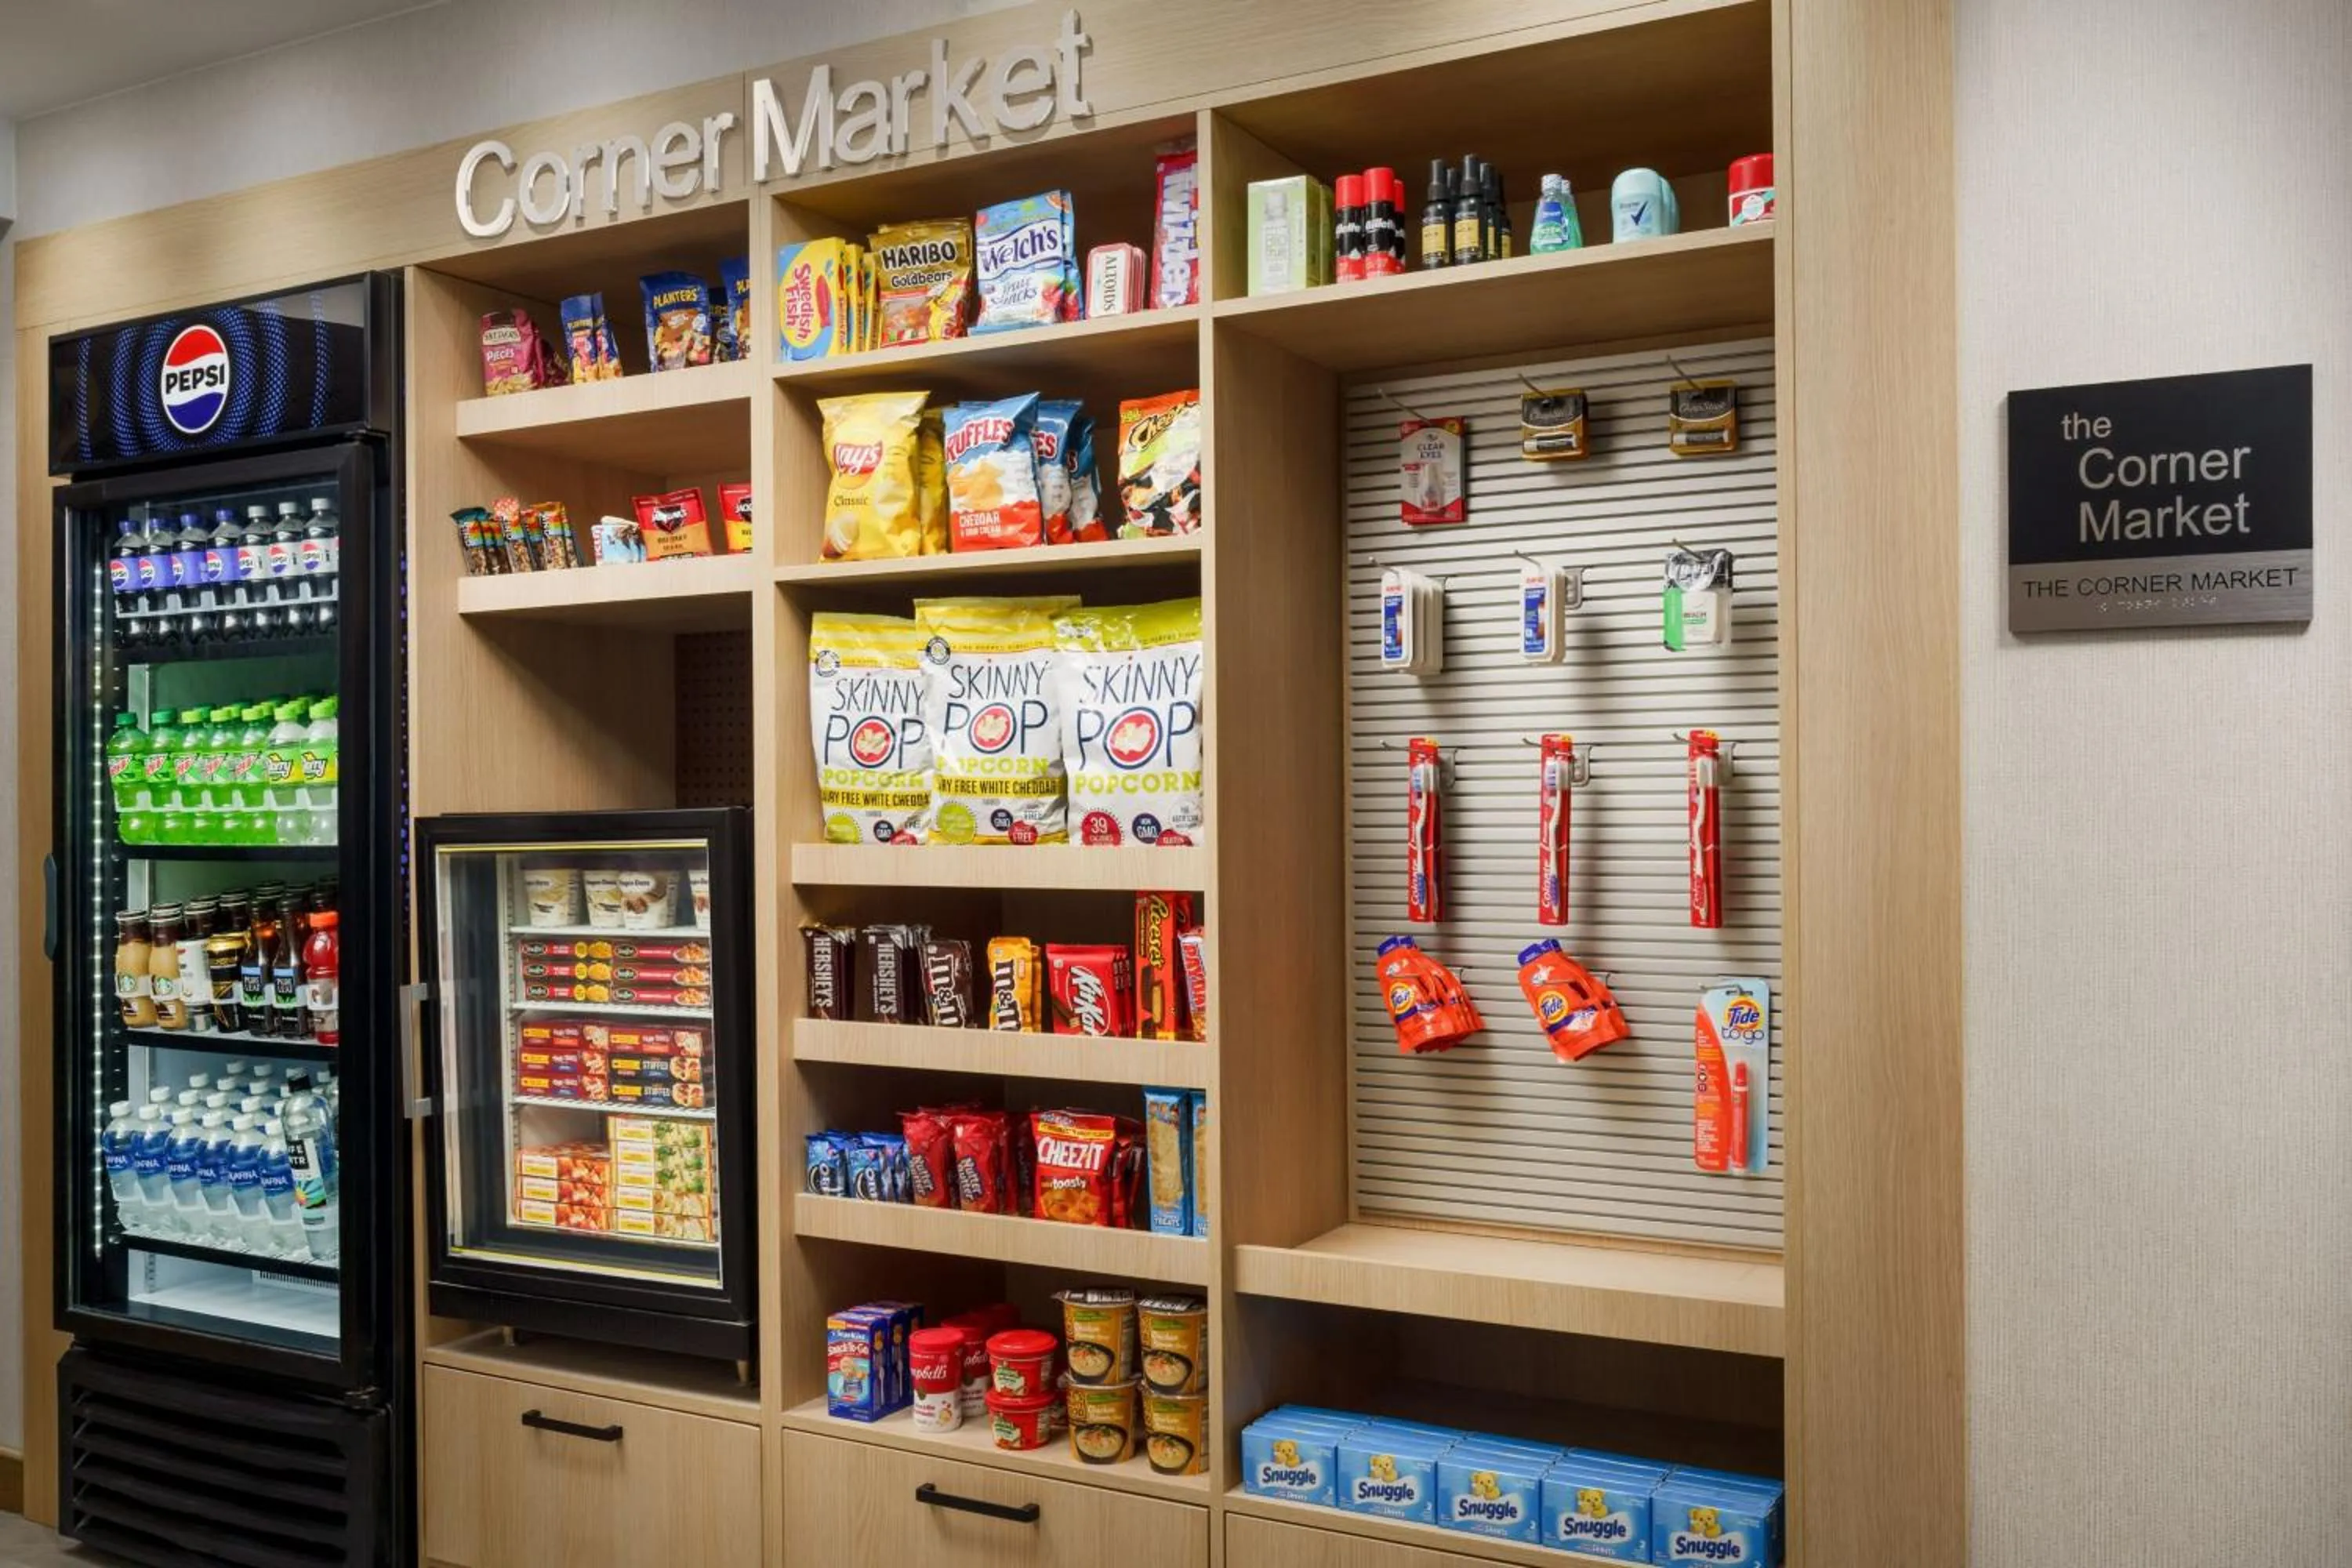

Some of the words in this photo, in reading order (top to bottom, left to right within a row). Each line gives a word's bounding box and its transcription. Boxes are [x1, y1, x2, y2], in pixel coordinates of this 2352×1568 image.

[455, 111, 735, 238] Corner
[752, 8, 1094, 184] Market
[880, 240, 956, 270] HARIBO
[982, 225, 1058, 274] Welch's
[891, 270, 953, 289] Goldbears
[653, 288, 698, 308] PLANTERS
[785, 285, 800, 327] Fish
[794, 263, 815, 342] Swedish
[165, 358, 227, 395] PEPSI
[946, 418, 1014, 463] RUFFLES
[2060, 412, 2113, 441] the
[837, 442, 881, 475] Lay's
[2078, 446, 2252, 490] Corner
[834, 495, 869, 507] Classic
[959, 512, 1000, 527] CHEDDAR
[2079, 492, 2252, 543] Market
[2022, 579, 2069, 599] THE
[2077, 573, 2183, 597] CORNER
[2190, 567, 2299, 593] MARKET
[831, 672, 925, 715] SKINNY
[948, 658, 1049, 700] SKINNY
[1077, 655, 1200, 705] SKINNY
[825, 714, 926, 769] POP
[943, 700, 1048, 754] POP
[1076, 701, 1196, 771] POP
[841, 792, 860, 805] FREE
[863, 793, 889, 807] WHITE
[892, 793, 930, 807] CHEDDA
[954, 779, 976, 793] FREE
[979, 779, 1011, 793] WHITE
[1013, 779, 1057, 794] CHEDDAR
[1075, 771, 1201, 797] POPCORN
[1090, 816, 1109, 834] 39
[1148, 895, 1169, 970] Reese's
[813, 936, 834, 1008] HERSHEY'S
[877, 942, 898, 1014] HERSHEY'S
[1541, 997, 1564, 1020] Tide
[1728, 1006, 1759, 1027] Tide
[1721, 1026, 1740, 1040] to
[1743, 1029, 1764, 1044] go
[1261, 1466, 1317, 1486] Snuggle
[1357, 1481, 1415, 1502] Snuggle
[1457, 1498, 1518, 1520] Snuggle
[1563, 1516, 1627, 1540] Snuggle
[1675, 1535, 1741, 1560] Snuggle
